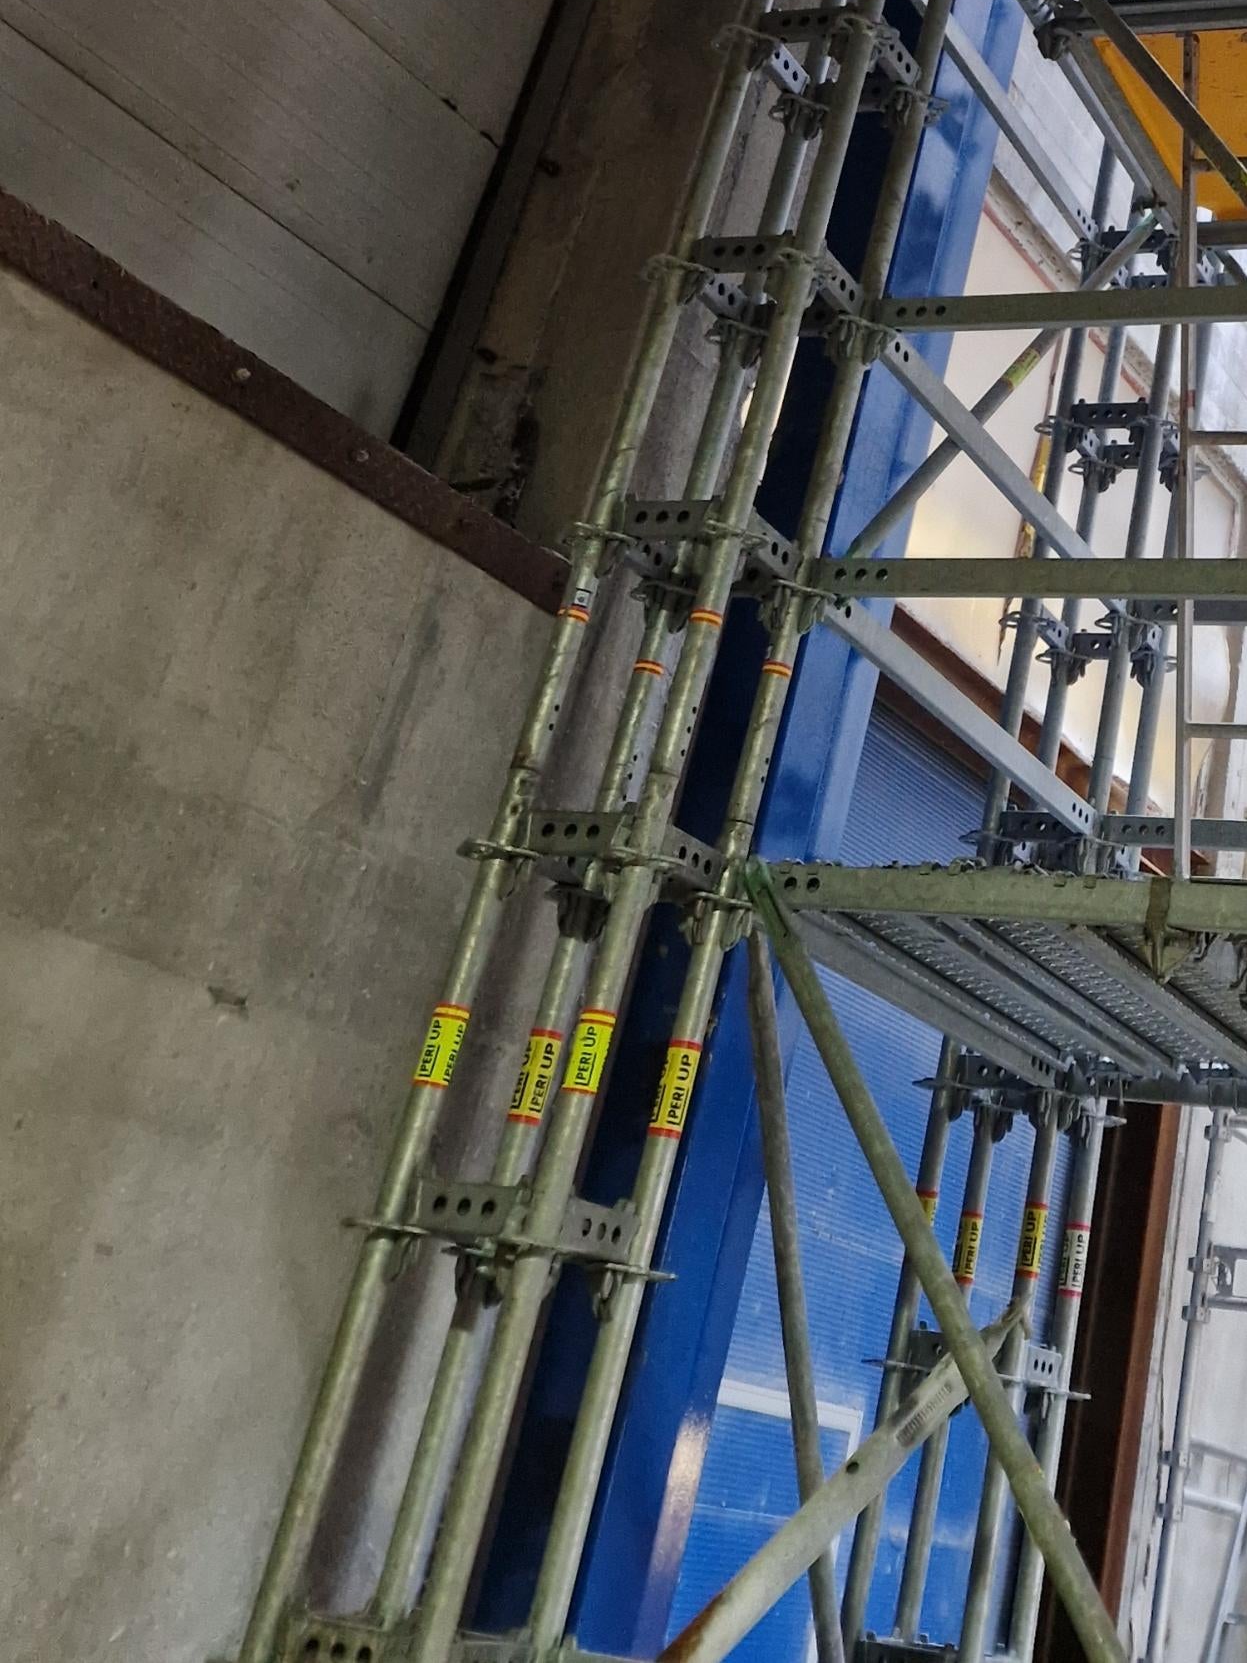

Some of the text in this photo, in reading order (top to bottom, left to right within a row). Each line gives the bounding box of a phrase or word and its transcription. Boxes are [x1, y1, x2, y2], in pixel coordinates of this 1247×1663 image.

[419, 1019, 442, 1072] PERI UP
[530, 1043, 555, 1107] PERI UP
[576, 1026, 598, 1081] PERI UP
[668, 1054, 692, 1119] PERI UP
